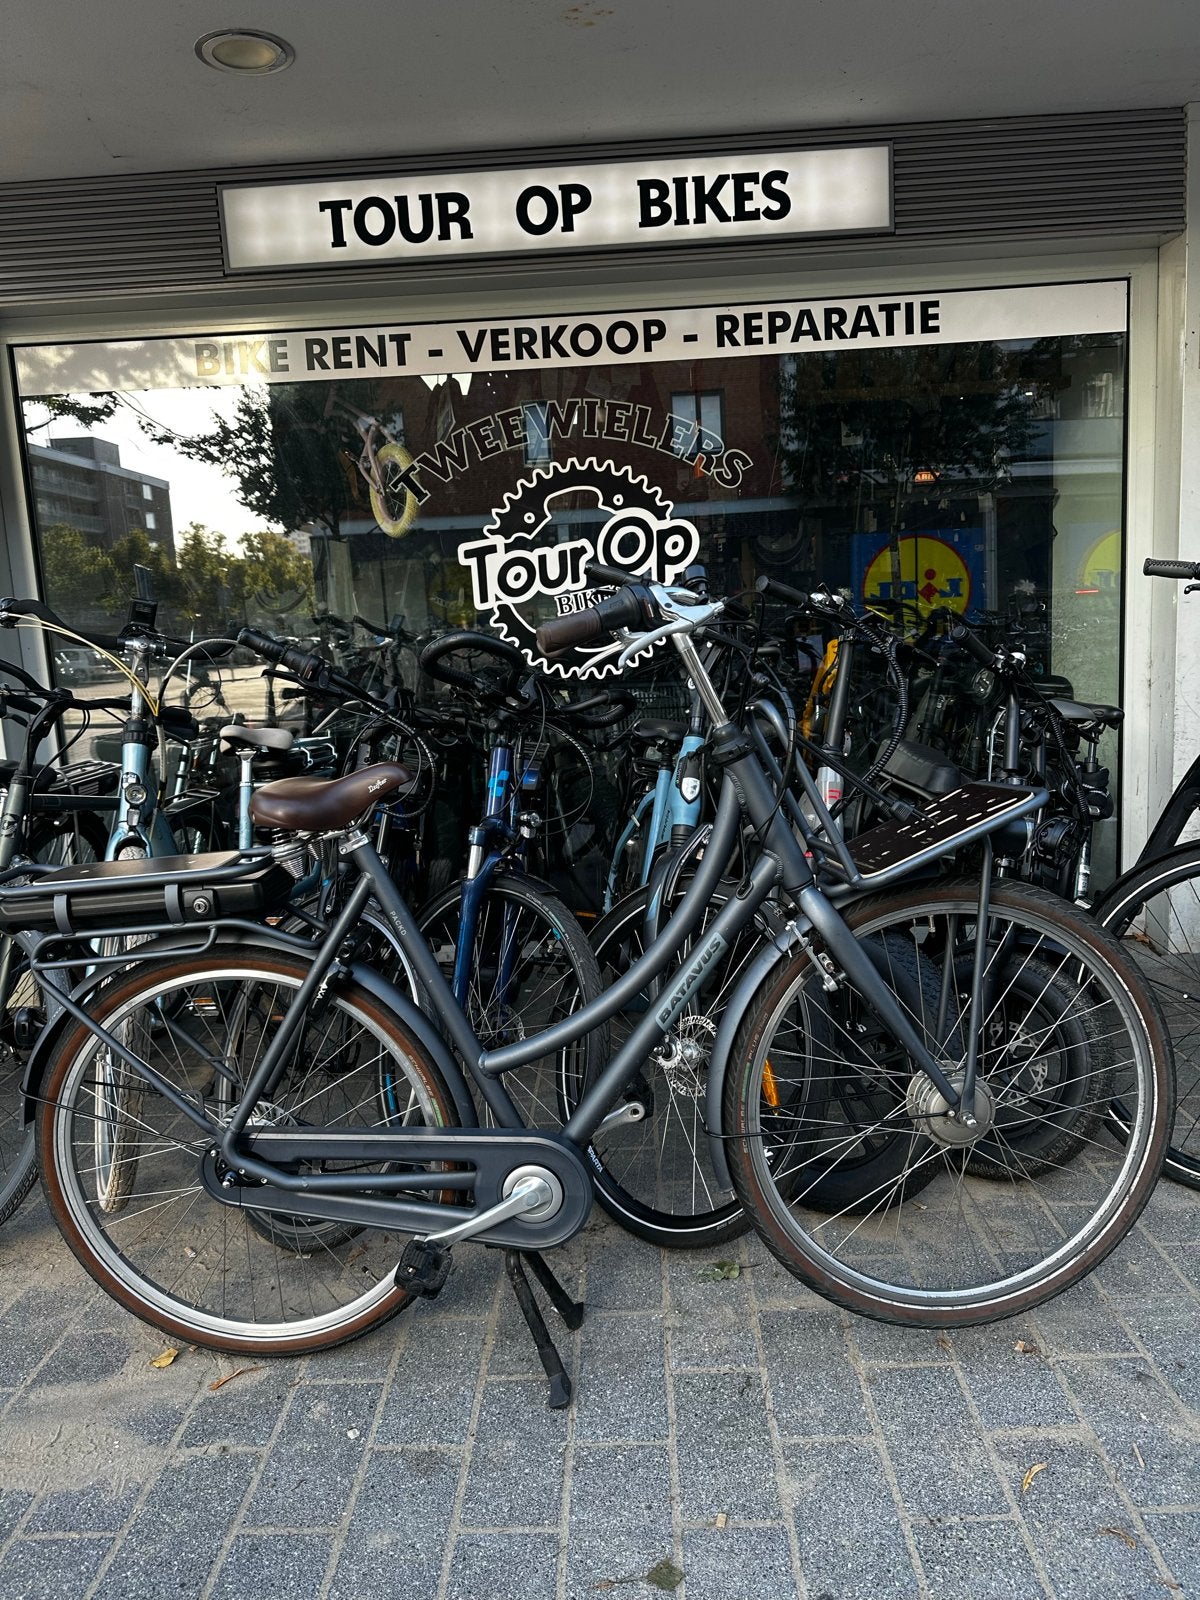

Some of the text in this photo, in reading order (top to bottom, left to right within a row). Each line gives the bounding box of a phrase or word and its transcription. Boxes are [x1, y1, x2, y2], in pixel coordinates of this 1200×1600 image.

[319, 170, 792, 248] TOUR OP BIKES
[195, 339, 290, 376] BIKE
[305, 333, 412, 371] RENT
[456, 318, 668, 364] VERKOOP
[715, 300, 941, 349] REPARATIE
[389, 398, 753, 506] TWEEWIELERS
[461, 511, 697, 607] Tour Op
[390, 910, 407, 936] PACKD
[659, 938, 721, 1024] BATAVUS
[587, 1145, 603, 1173] SPARTA
